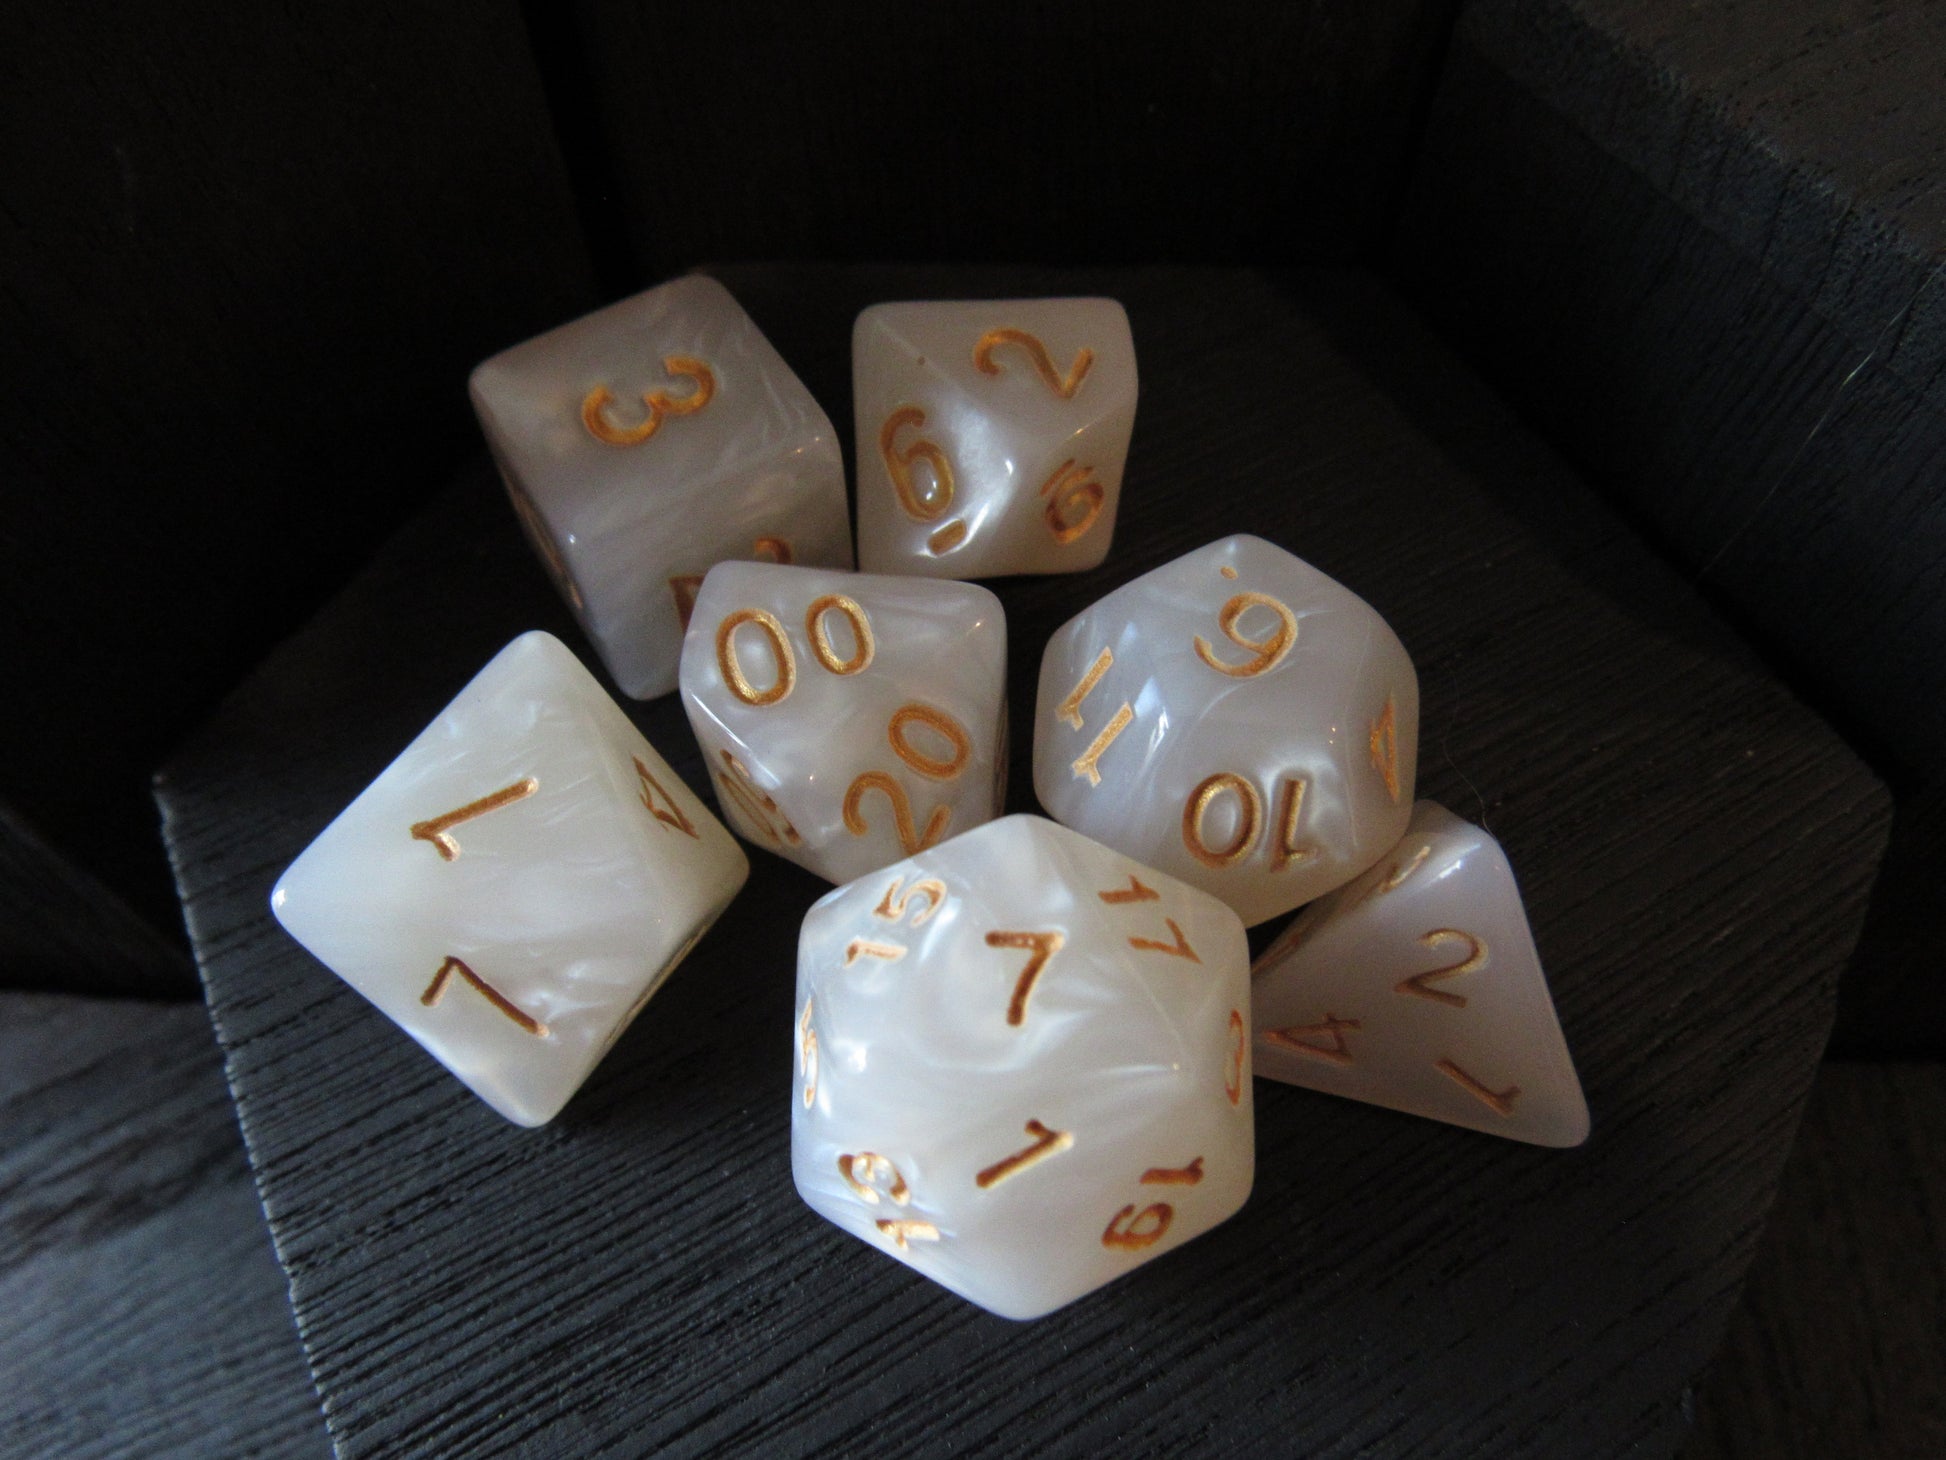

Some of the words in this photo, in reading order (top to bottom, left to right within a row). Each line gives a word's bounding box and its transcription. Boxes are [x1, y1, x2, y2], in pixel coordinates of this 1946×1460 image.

[582, 356, 717, 446] 3
[972, 327, 1094, 398] 2
[715, 594, 876, 707] 00
[1055, 645, 1135, 789] 11
[411, 776, 541, 862] 1
[842, 703, 972, 856] 20
[1181, 771, 1318, 876] 10
[843, 876, 948, 969] 15
[1099, 874, 1203, 964] 17
[985, 929, 1066, 1027] 7
[1394, 928, 1490, 1009] 2
[1261, 1012, 1362, 1068] 4
[1435, 1056, 1522, 1117] 1
[975, 1118, 1076, 1190] 1
